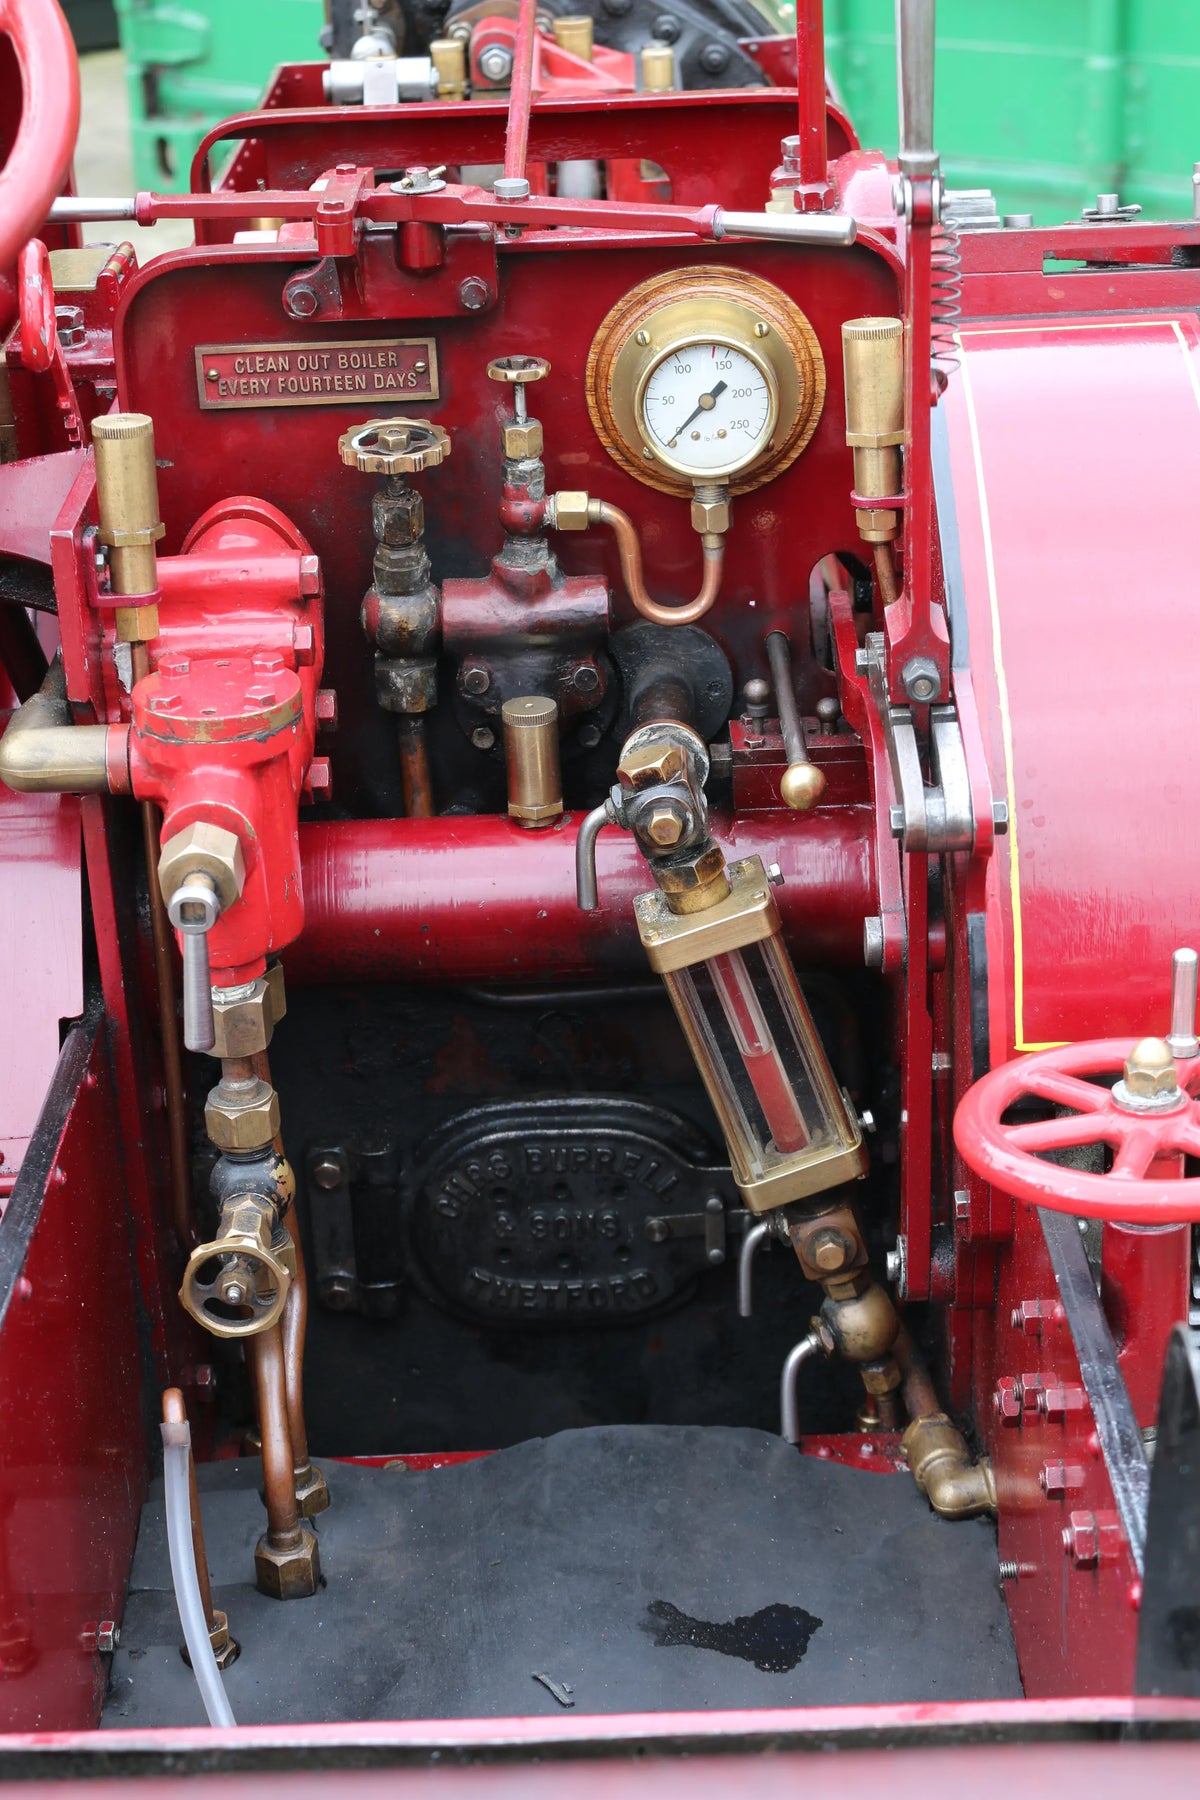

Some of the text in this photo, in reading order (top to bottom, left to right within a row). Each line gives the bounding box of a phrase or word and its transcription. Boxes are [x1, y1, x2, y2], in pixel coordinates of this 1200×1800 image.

[234, 351, 398, 374] CLEAN OUT BOILER
[674, 364, 692, 374] 100
[715, 360, 732, 371] 150
[218, 372, 417, 397] EVERY FOURTEEN DAYS
[662, 395, 675, 405] 50
[731, 388, 752, 399] 200
[729, 419, 750, 430] 250
[525, 1144, 680, 1204] BURRELL
[495, 1209, 620, 1240] & SONS
[466, 1266, 657, 1311] THETFORD
